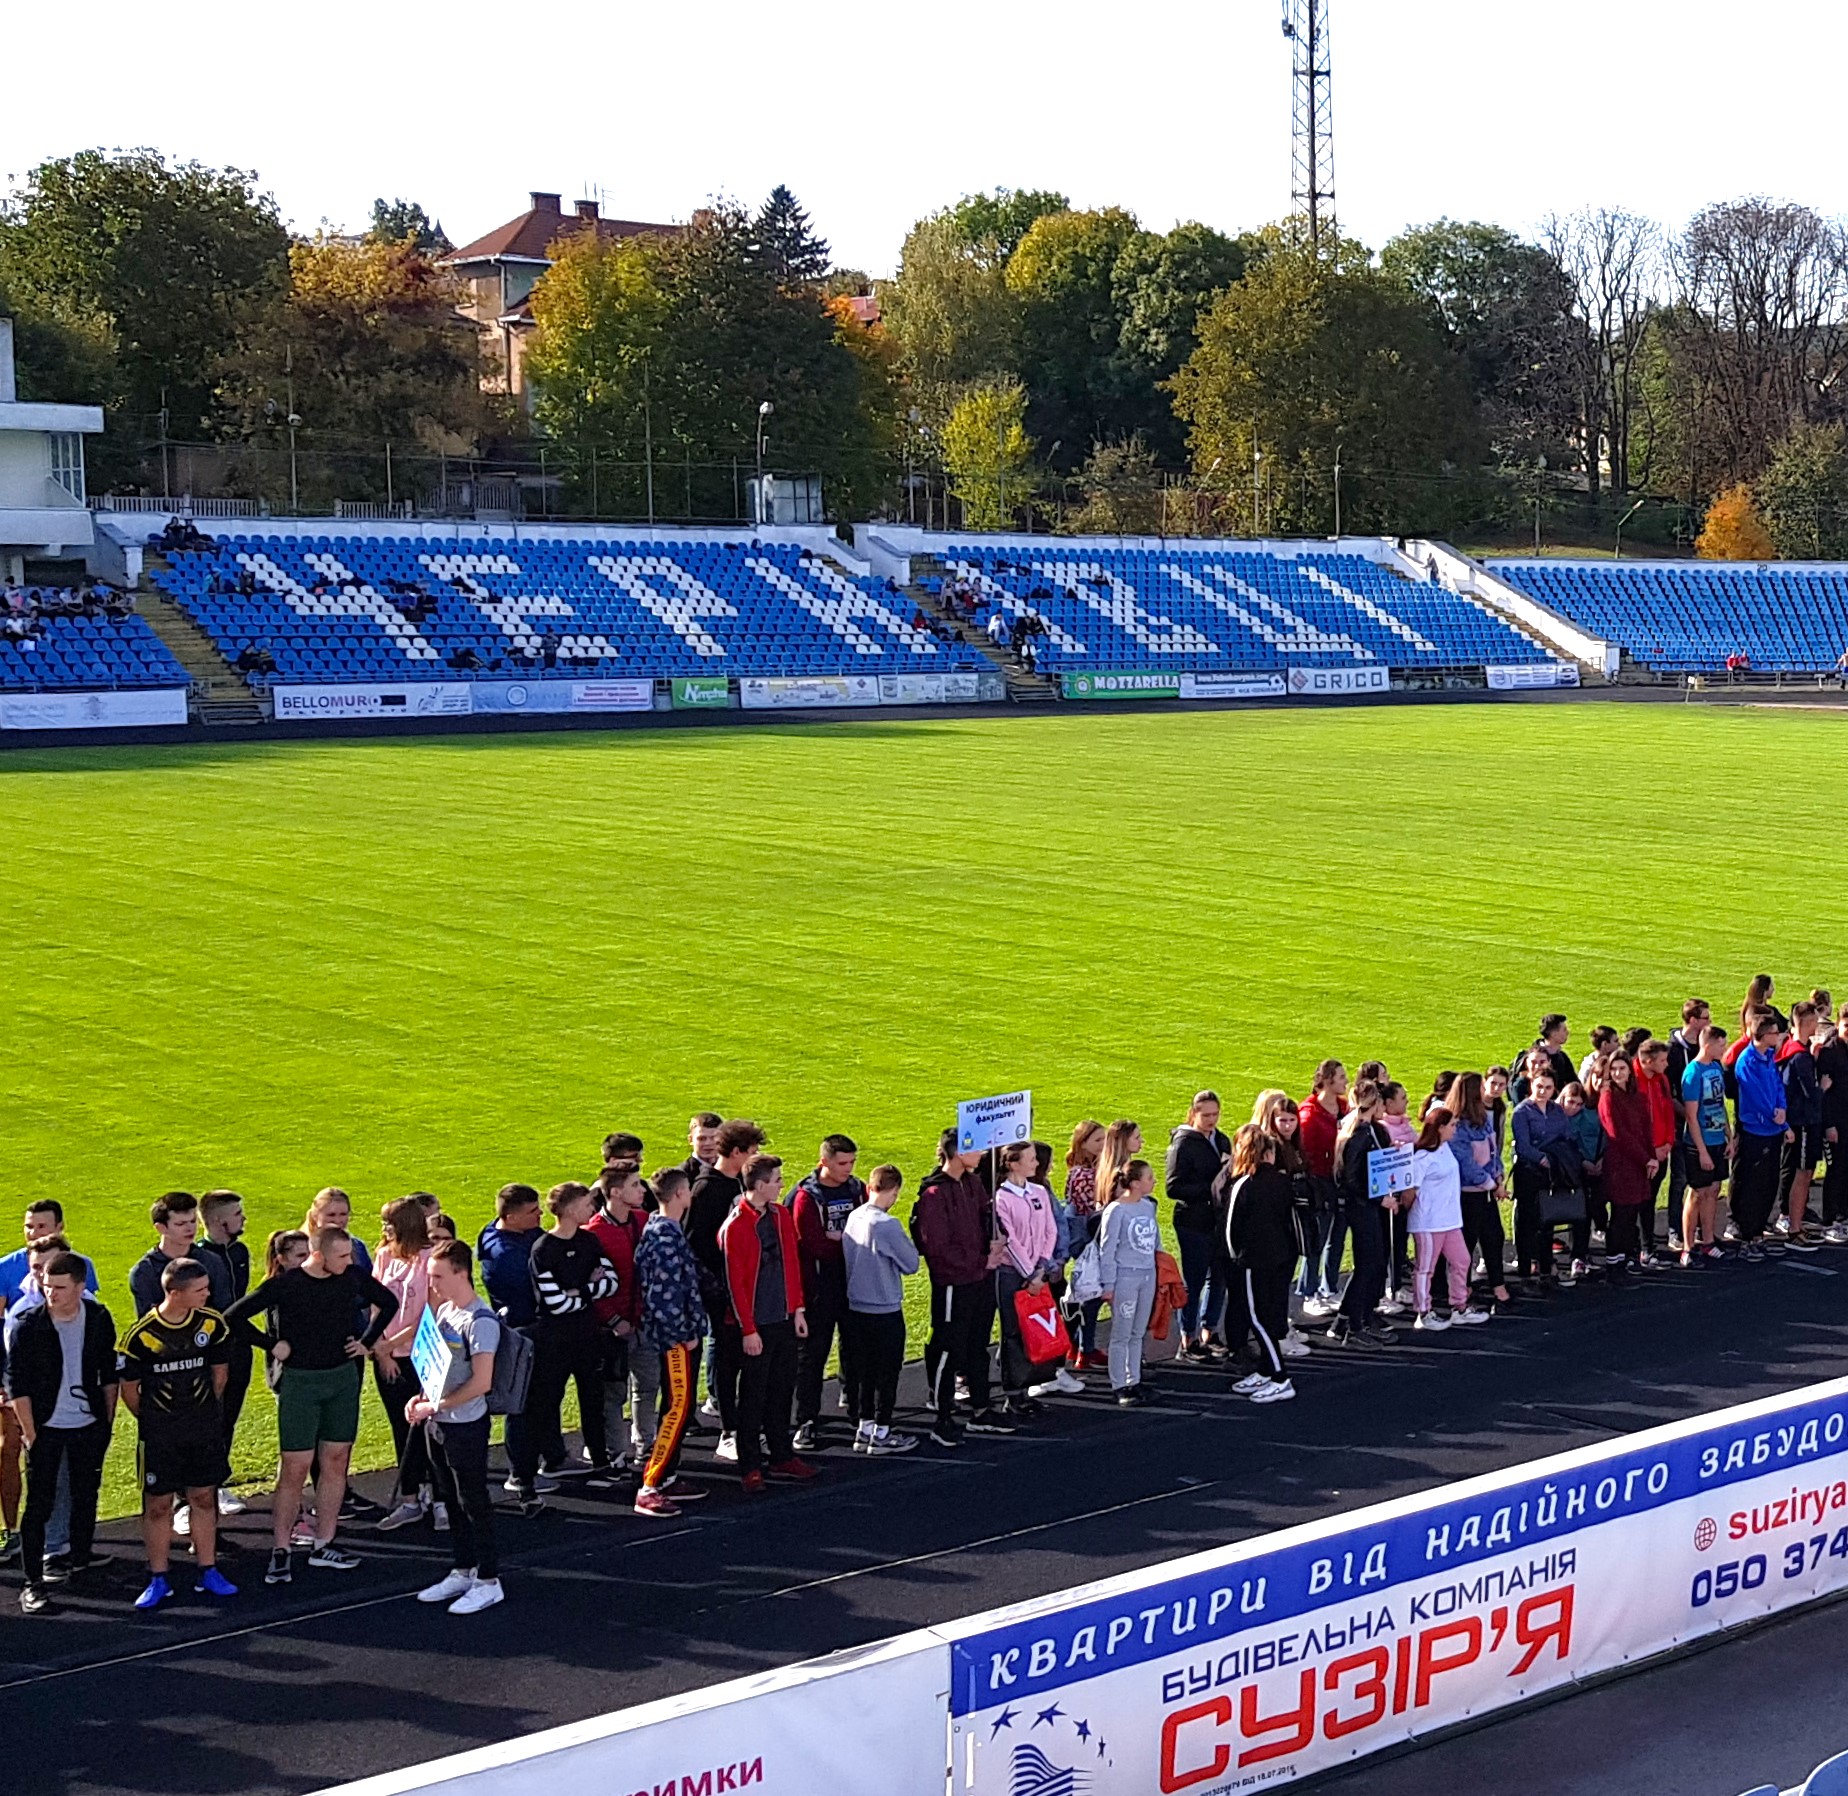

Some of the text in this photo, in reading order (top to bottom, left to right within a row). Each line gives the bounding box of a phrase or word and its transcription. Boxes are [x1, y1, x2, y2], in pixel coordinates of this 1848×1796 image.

[1094, 675, 1179, 690] MOZZARELLA
[1314, 671, 1382, 688] GRICO
[966, 1093, 1024, 1113] ЮРИДИЧНИЙ
[989, 1578, 1267, 1690] КВАРТИРИ
[1308, 1541, 1388, 1595] ВІД
[1425, 1462, 1670, 1560] НАДІЙНОГО
[1691, 1567, 1767, 1608] 050
[1162, 1547, 1577, 1704] БУДІВЕЛЬНА КОМПАНІЯ
